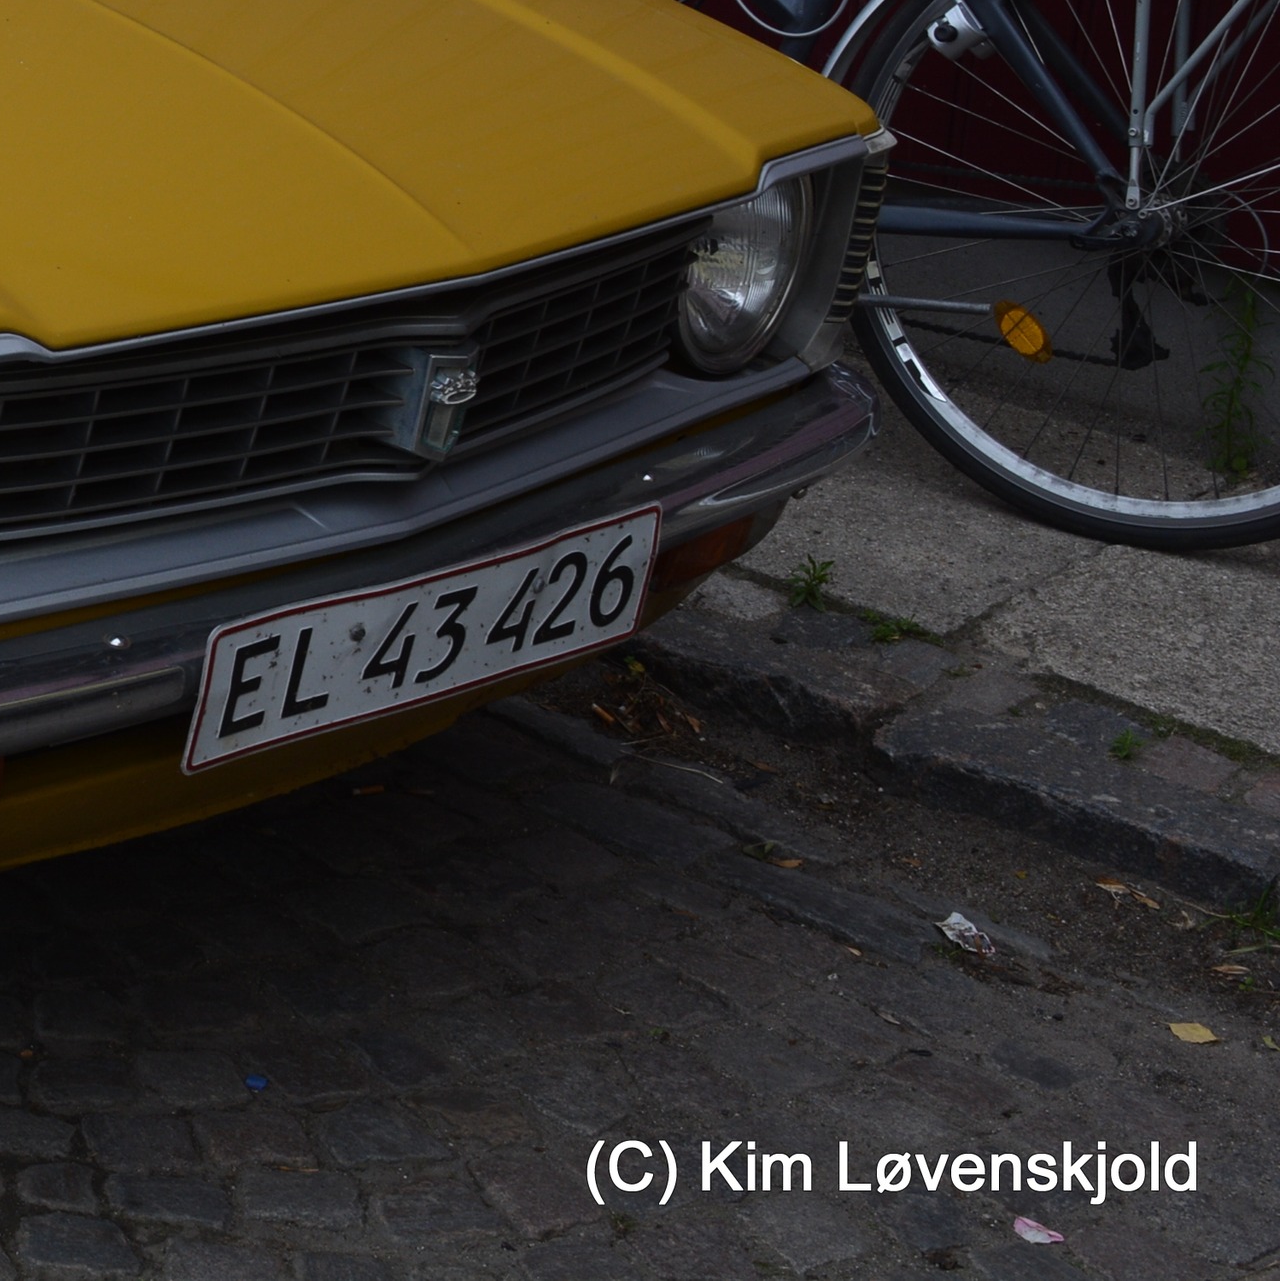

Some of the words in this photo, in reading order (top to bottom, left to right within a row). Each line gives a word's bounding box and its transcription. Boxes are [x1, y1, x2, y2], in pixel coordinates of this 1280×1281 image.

[217, 627, 329, 739] EL
[362, 585, 479, 689] 43
[485, 534, 635, 653] 426
